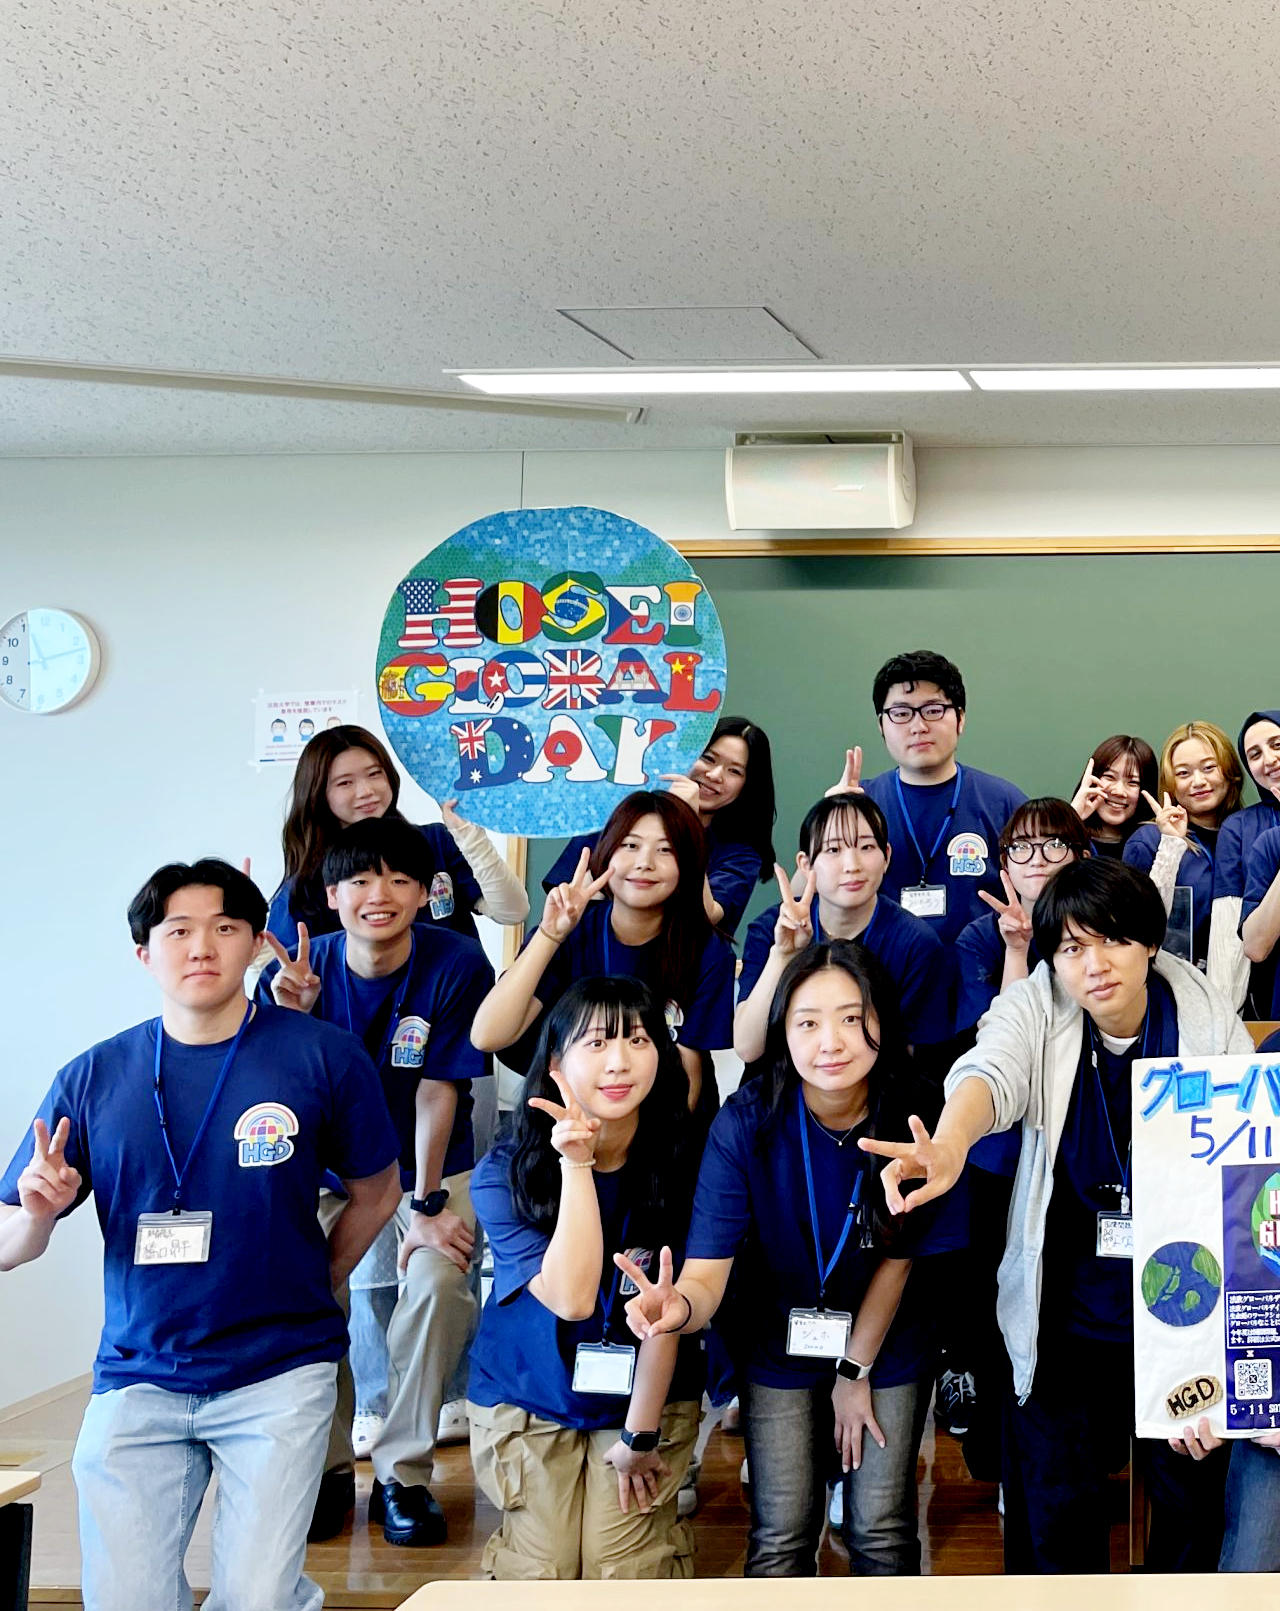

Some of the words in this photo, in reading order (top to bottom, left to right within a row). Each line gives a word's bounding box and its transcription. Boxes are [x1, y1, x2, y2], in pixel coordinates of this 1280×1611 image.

[398, 571, 703, 647] HOSEI
[8, 637, 19, 648] 10
[2, 656, 9, 666] 9
[6, 675, 13, 685] 8
[377, 648, 722, 717] GLOBAL
[20, 688, 26, 698] 7
[450, 714, 676, 791] DAY
[952, 857, 986, 874] HGD
[395, 1046, 423, 1065] HG
[243, 1141, 291, 1164] HGD
[1168, 1378, 1214, 1416] HGD
